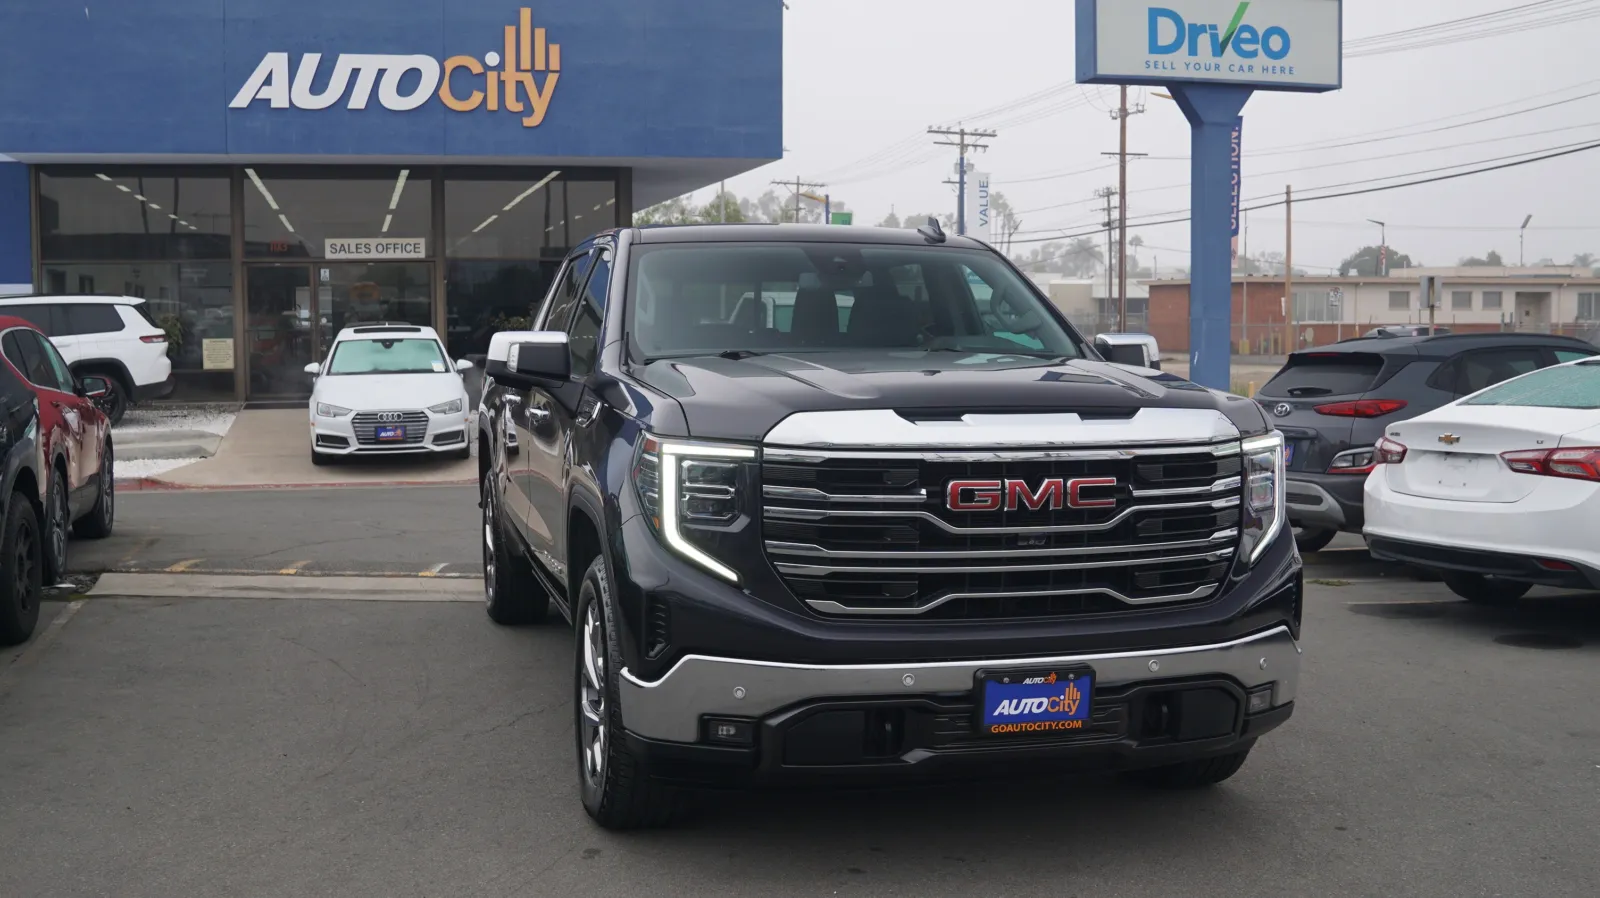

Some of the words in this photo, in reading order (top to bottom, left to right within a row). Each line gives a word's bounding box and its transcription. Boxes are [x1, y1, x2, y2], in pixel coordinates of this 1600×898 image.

[1145, 60, 1176, 70] SELL
[1184, 62, 1221, 72] YOUR
[1228, 64, 1254, 73] CAR
[1262, 65, 1295, 75] HERE
[329, 242, 372, 254] SALES
[375, 242, 421, 254] OFFICE
[947, 477, 1116, 511] GMC
[991, 720, 1082, 733] GOAUTOCITY.COM
